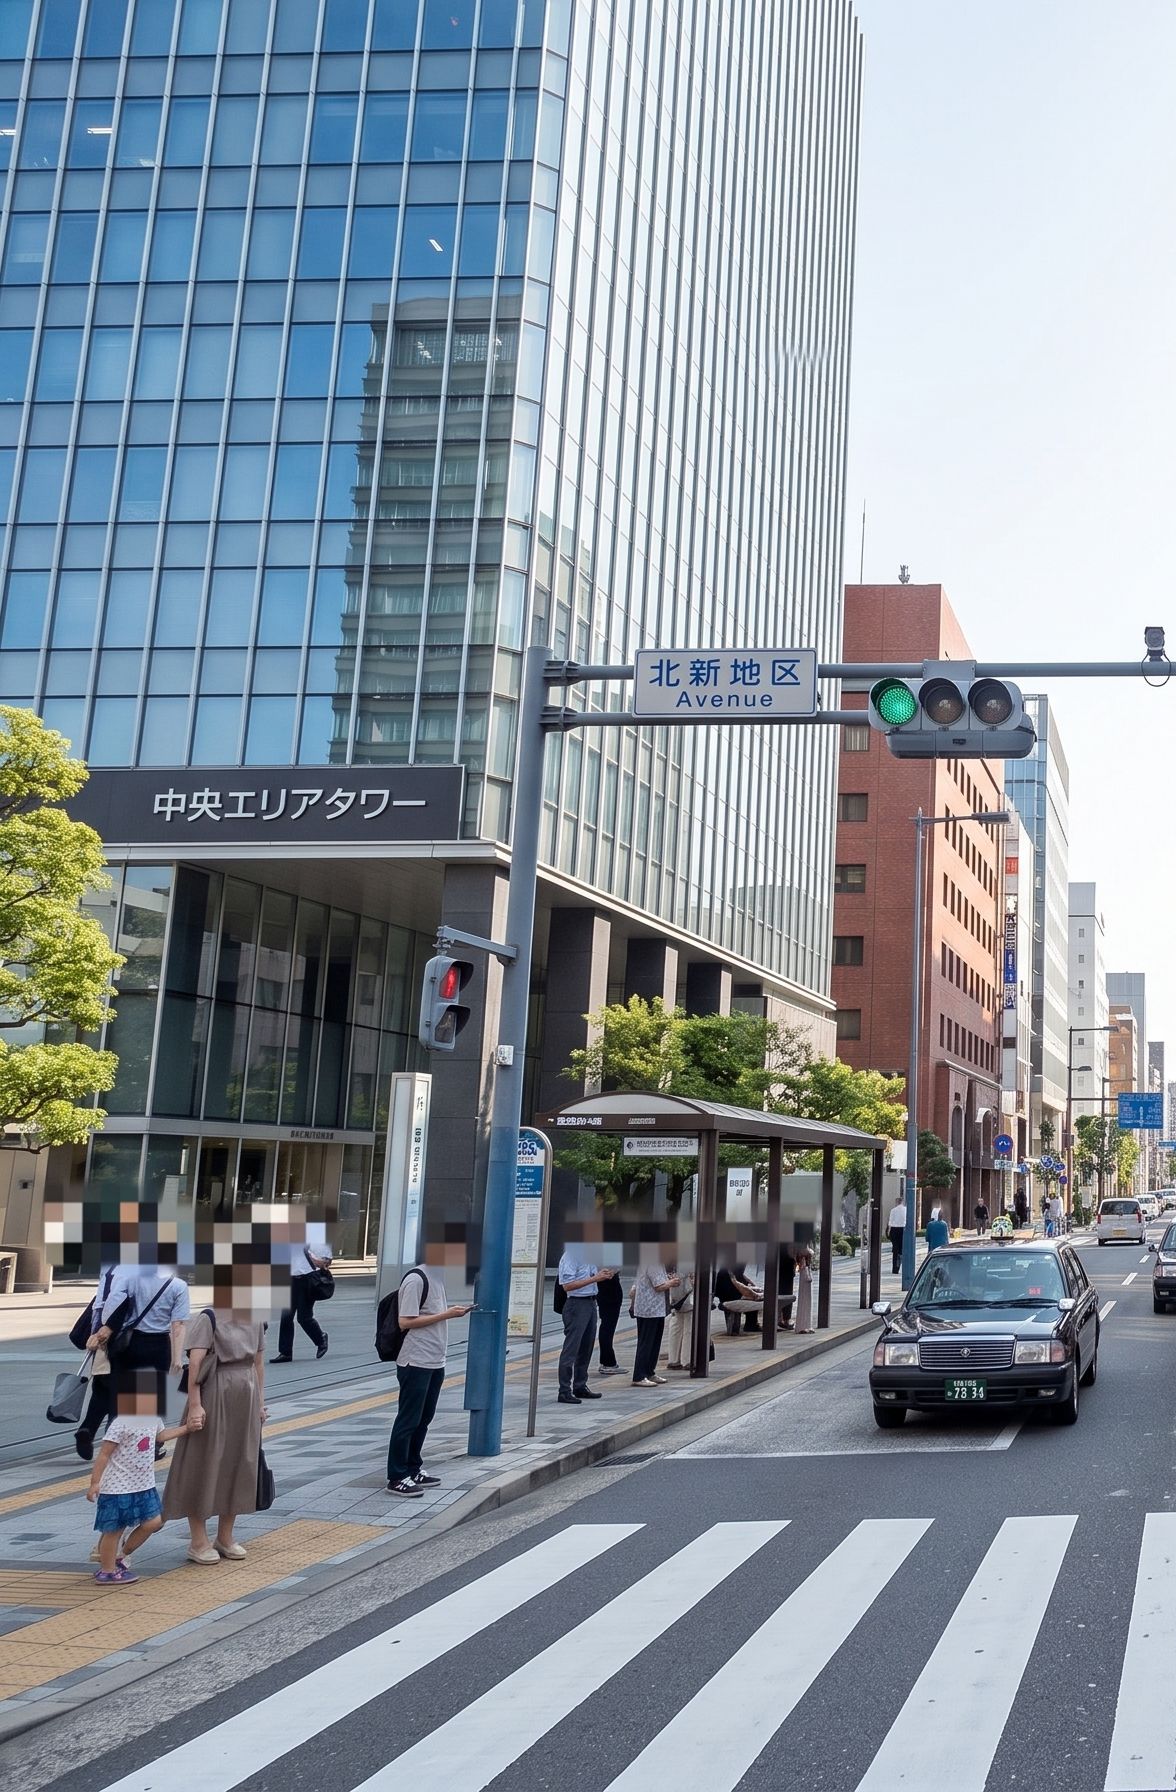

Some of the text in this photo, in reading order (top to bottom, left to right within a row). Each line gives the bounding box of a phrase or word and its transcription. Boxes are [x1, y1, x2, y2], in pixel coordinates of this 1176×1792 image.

[649, 658, 801, 687] 北新地区
[676, 691, 773, 708] Avenue
[153, 787, 426, 822] 中央エリアタワー
